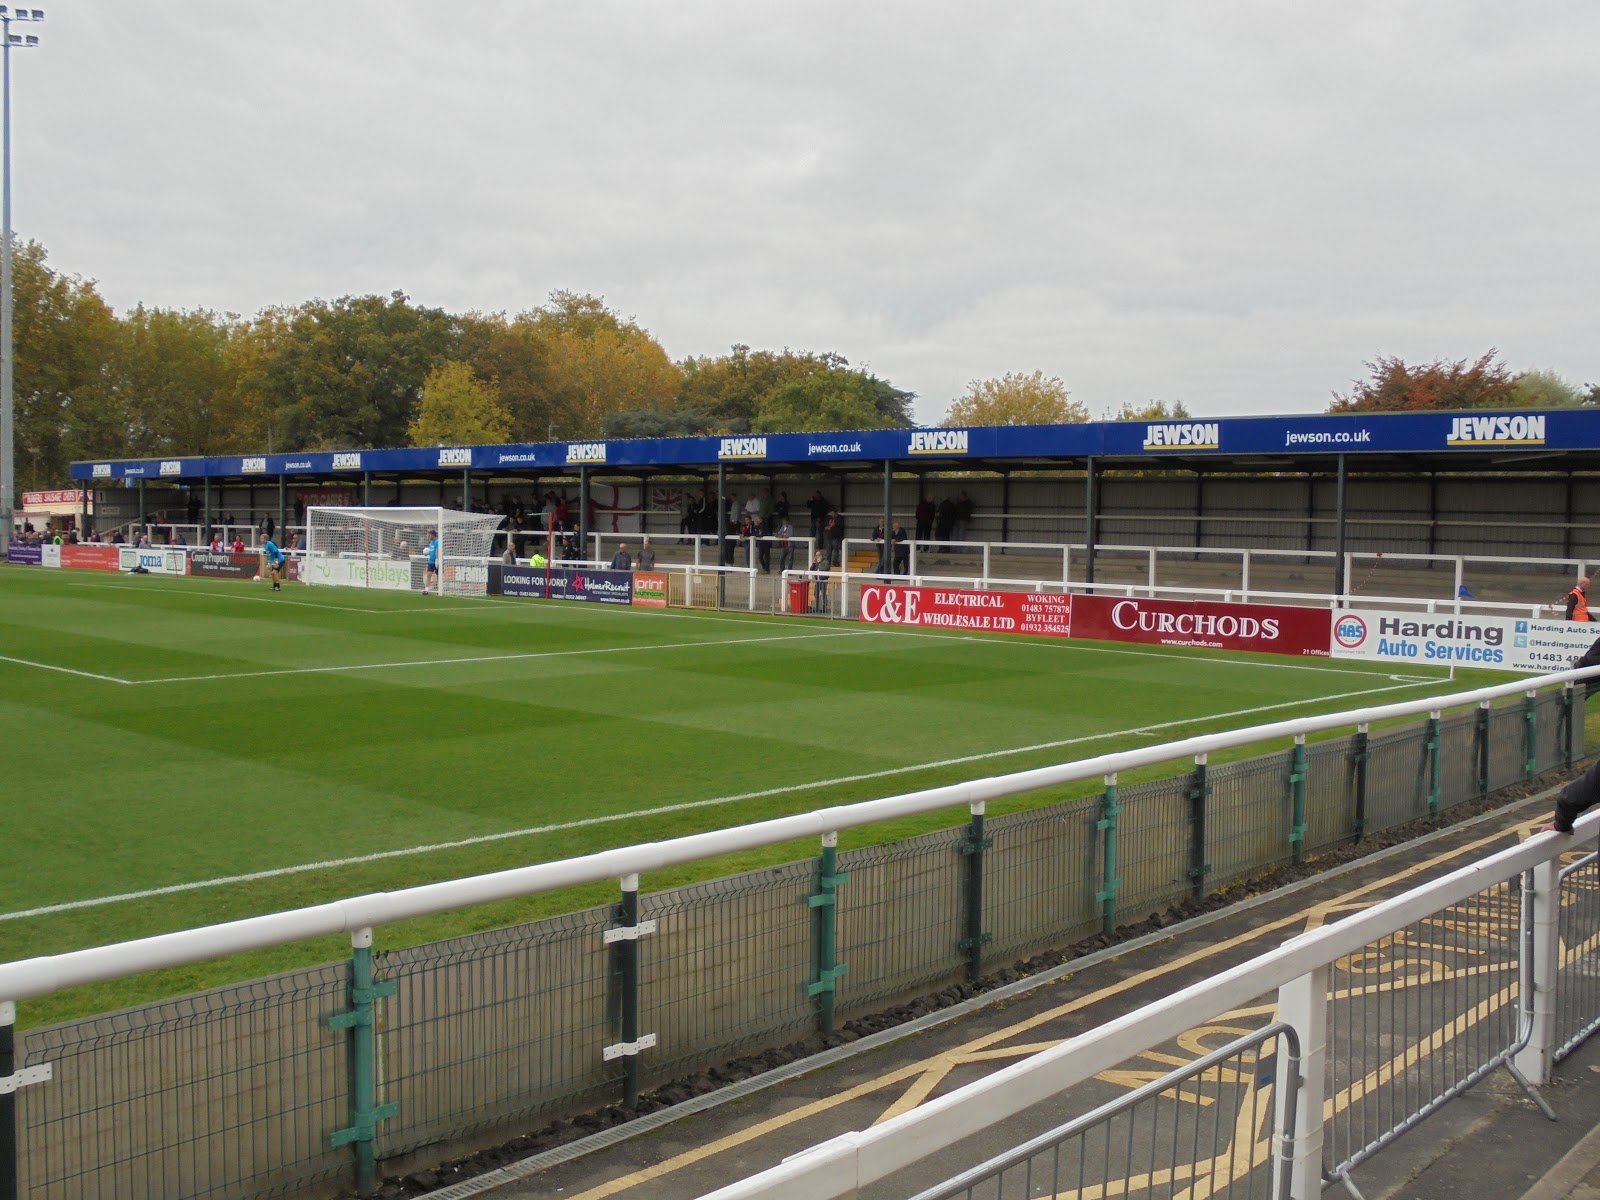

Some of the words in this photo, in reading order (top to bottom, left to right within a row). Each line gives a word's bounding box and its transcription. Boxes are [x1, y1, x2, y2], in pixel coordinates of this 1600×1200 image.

[1143, 423, 1218, 445] JEWSON
[1447, 416, 1545, 440] JEWSON
[908, 431, 968, 450] JEWSON
[1285, 429, 1370, 446] jewson.co.uk
[566, 443, 606, 459] JEWSON
[718, 438, 766, 455] JEWSON
[808, 442, 861, 455] jewson.co.uk
[332, 453, 360, 467] JEWSON
[438, 449, 471, 463] JEWSON
[499, 452, 535, 463] jewson.co.uk
[160, 461, 180, 473] JEWSON
[241, 457, 266, 471] JEWSON
[191, 551, 208, 564] County
[208, 552, 229, 566] Property
[347, 562, 409, 587] Tremblays
[503, 575, 530, 585] LOOKING
[531, 576, 544, 586] FOR
[635, 578, 663, 592] iprint
[861, 588, 921, 624] C&E
[934, 592, 1004, 608] ELECTRICAL
[1027, 594, 1065, 604] WOKING
[1021, 604, 1042, 613] 01483
[1044, 605, 1070, 614] 757878
[923, 612, 990, 628] WHOLESALE
[993, 616, 1015, 630] LTD
[1026, 613, 1065, 623] BYFLEET
[1111, 600, 1279, 640] CURCHODS
[1021, 623, 1042, 632] 01932
[1338, 625, 1363, 638] HAS
[1380, 617, 1503, 646] Harding
[1531, 624, 1564, 634] Harding
[1566, 626, 1587, 634] Auto
[1161, 638, 1223, 648] www.curchods.com
[1377, 638, 1418, 657] Auto
[1424, 641, 1504, 663] Services
[1529, 652, 1562, 662] 01483
